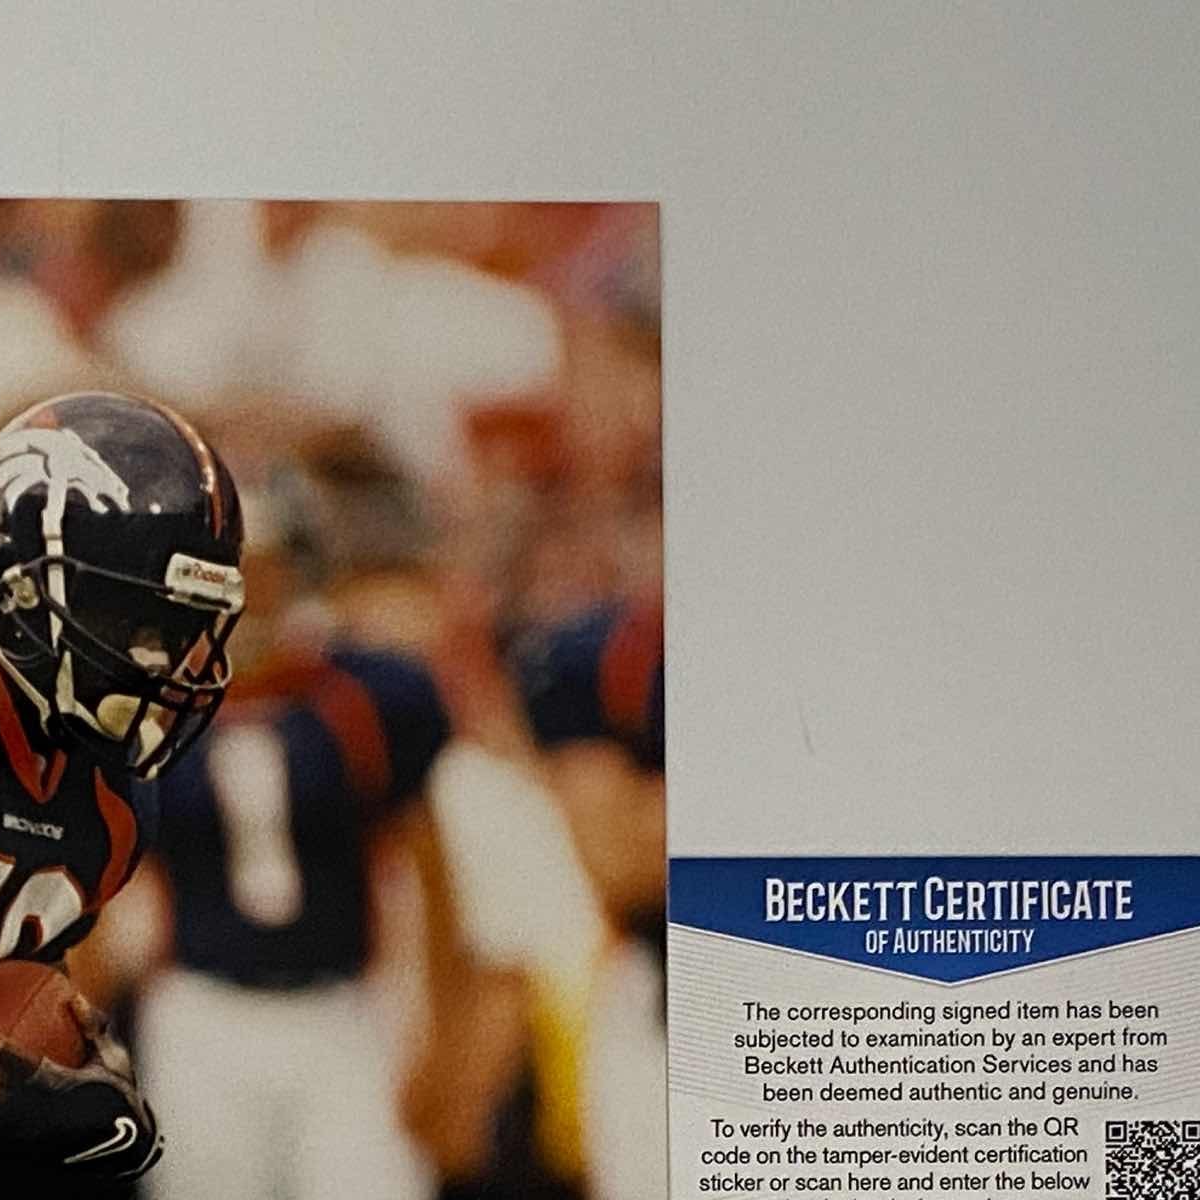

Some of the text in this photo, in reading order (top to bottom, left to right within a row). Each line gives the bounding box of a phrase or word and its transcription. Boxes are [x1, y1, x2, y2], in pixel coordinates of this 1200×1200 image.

[764, 875, 1134, 922] BECKETT CERTIFICATE
[865, 927, 1035, 955] OF AUTHENTICITY
[742, 999, 1160, 1026] The corresponding signed item has been
[734, 1025, 1168, 1053] subjected to examination by an expert from
[744, 1053, 1159, 1075] Beckett Authentication Services and has
[762, 1081, 1139, 1106] been deemed authentic and genuine.
[709, 1116, 1079, 1143] To verify the authenticity, scan the QR
[700, 1144, 1088, 1169] code on the tamper-evident certification
[698, 1170, 1091, 1192] sticker or scan here and enter the below
